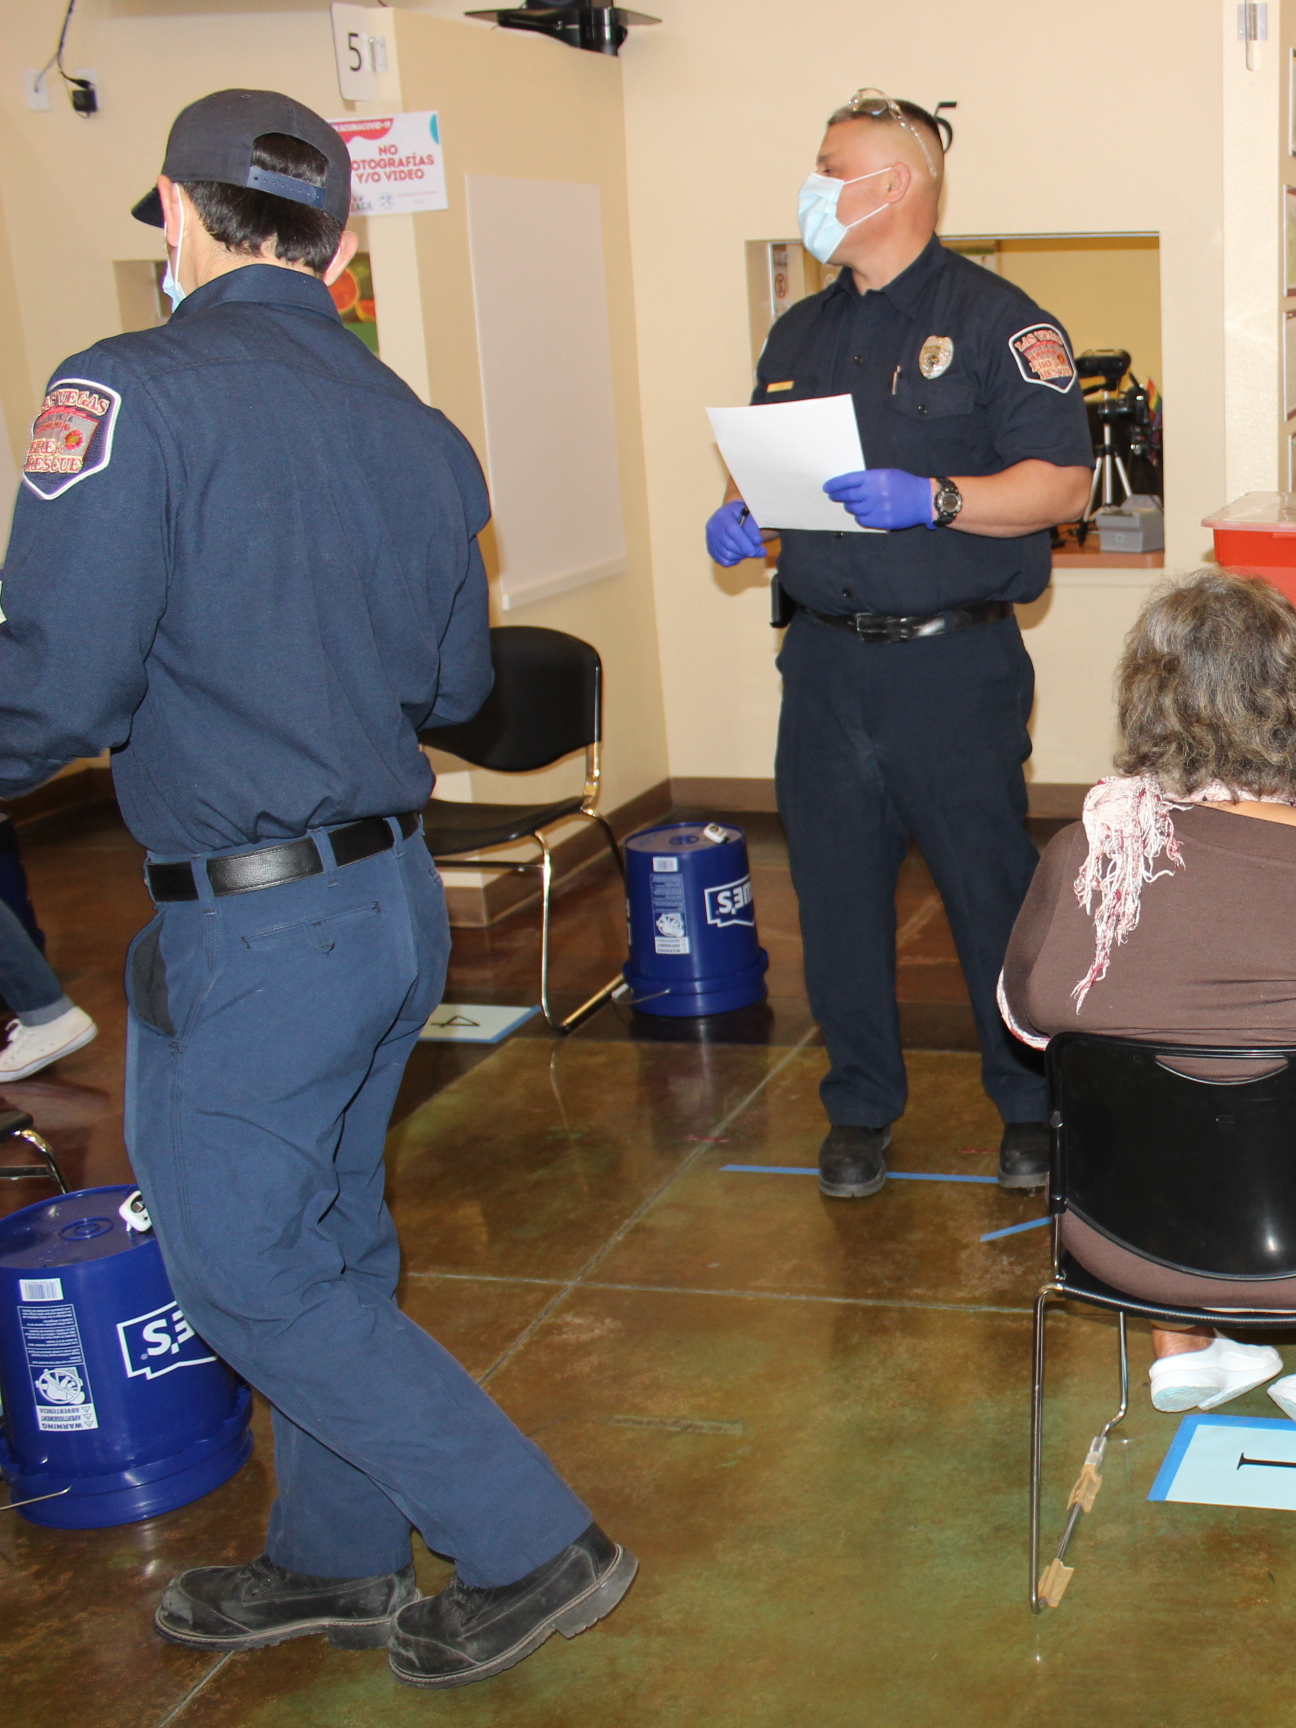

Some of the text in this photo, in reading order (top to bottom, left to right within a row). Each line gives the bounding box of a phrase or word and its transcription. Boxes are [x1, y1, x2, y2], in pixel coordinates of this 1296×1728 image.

[348, 32, 362, 72] 5
[932, 101, 957, 153] 5
[351, 152, 435, 171] OTOGRAFÍAS
[378, 144, 398, 156] NO
[356, 168, 425, 184] Y/O VIDEO
[58, 388, 110, 415] VEGAS
[24, 455, 83, 473] RESCUE
[142, 1309, 196, 1357] E'S
